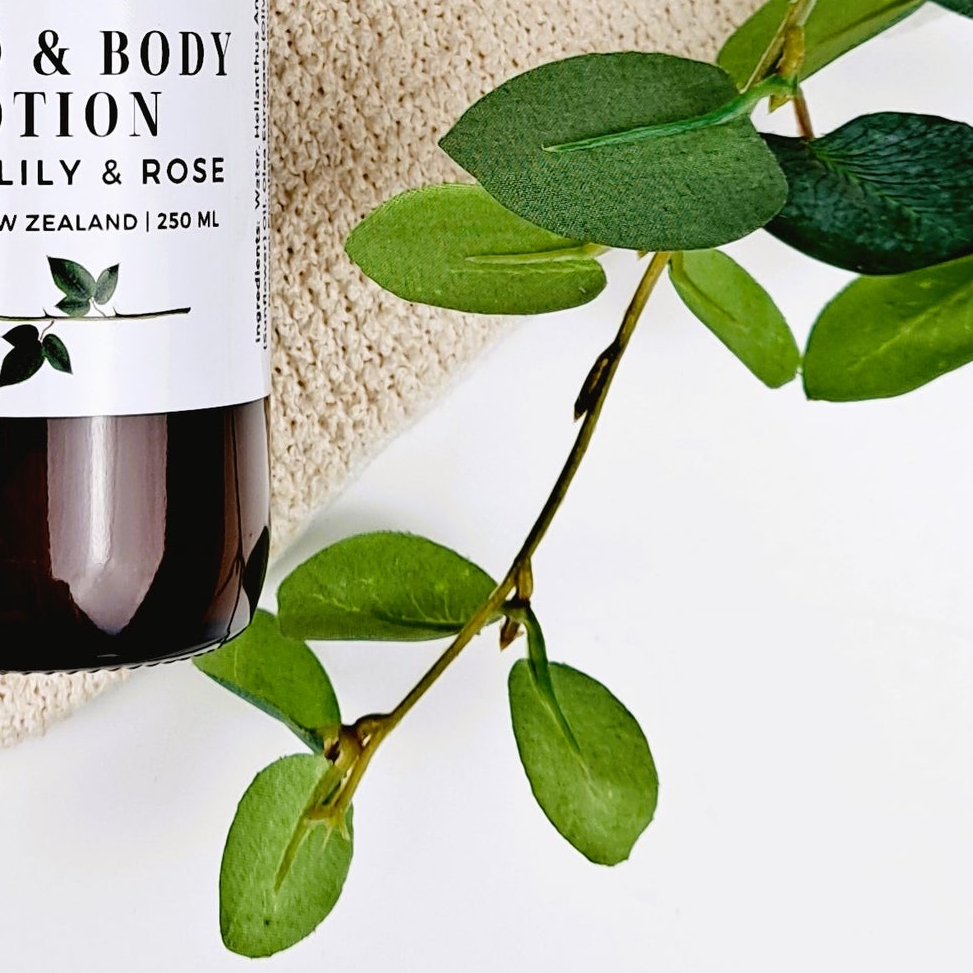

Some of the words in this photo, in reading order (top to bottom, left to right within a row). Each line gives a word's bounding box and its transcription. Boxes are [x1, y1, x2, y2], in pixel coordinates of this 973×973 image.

[33, 30, 71, 76] &
[100, 30, 231, 76] BODY
[102, 159, 121, 185] &
[143, 157, 224, 184] ROSE
[26, 214, 137, 231] ZEALAND
[158, 212, 191, 229] 250
[198, 211, 219, 228] ML
